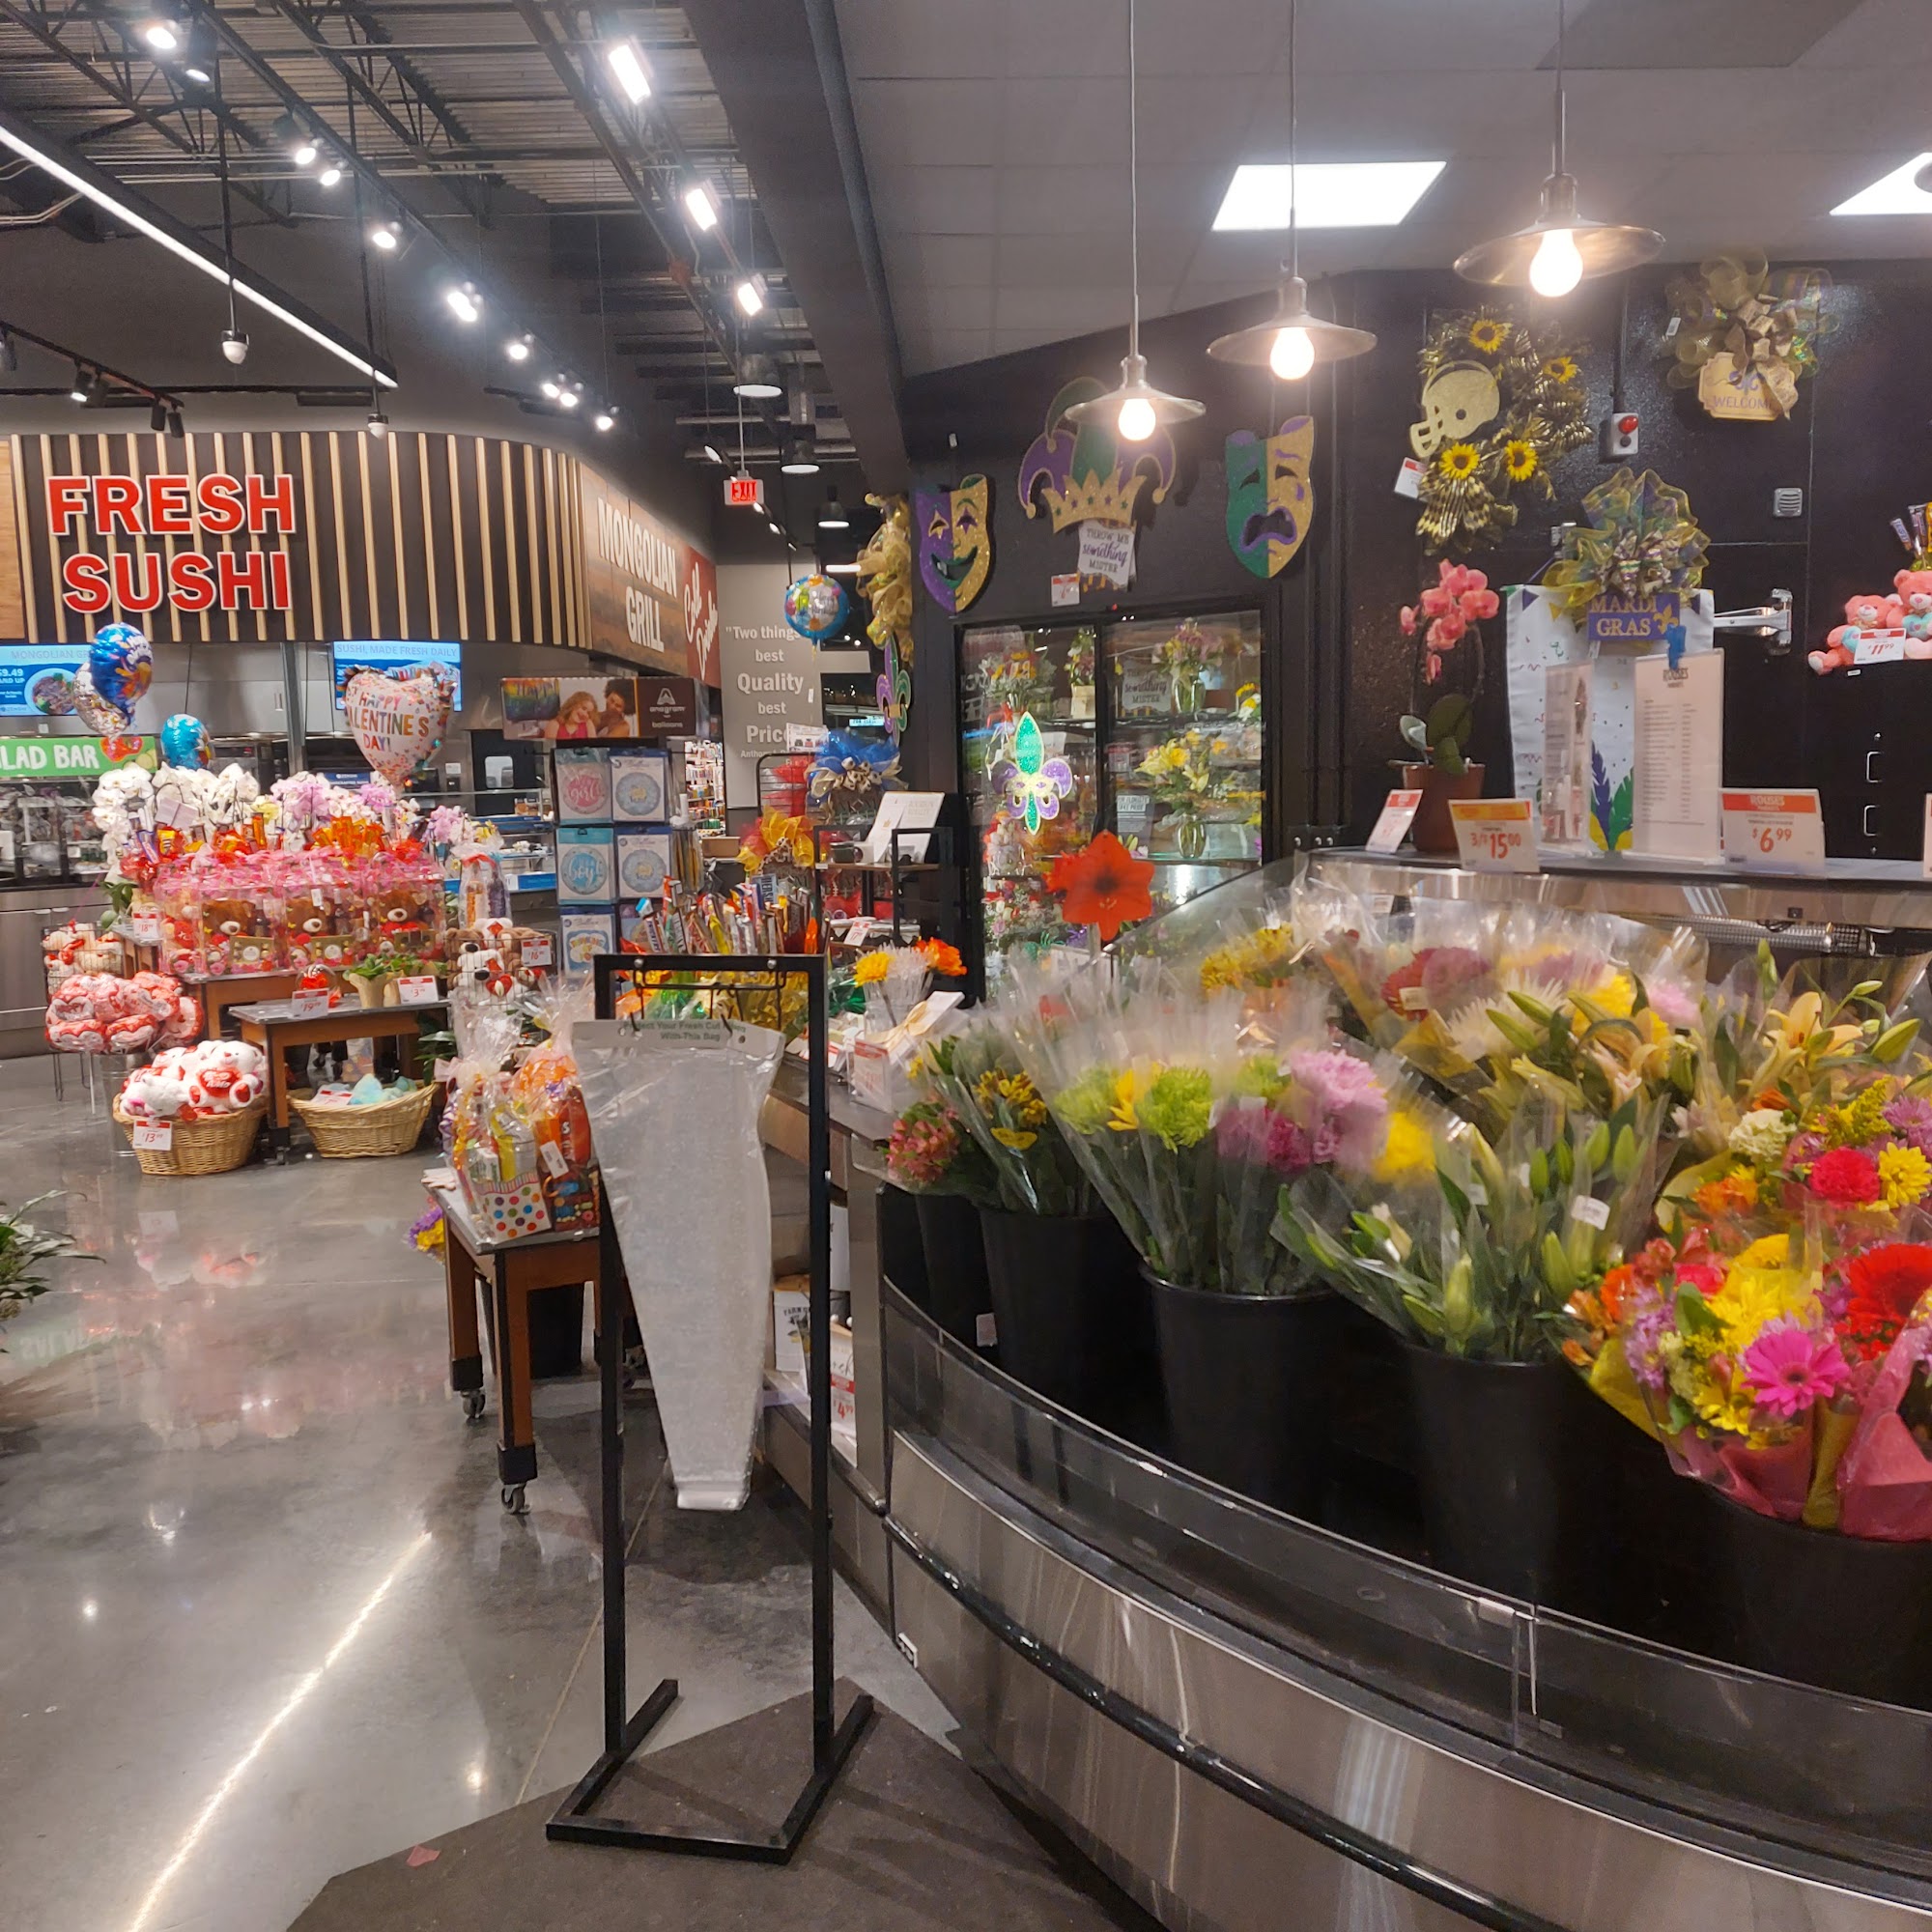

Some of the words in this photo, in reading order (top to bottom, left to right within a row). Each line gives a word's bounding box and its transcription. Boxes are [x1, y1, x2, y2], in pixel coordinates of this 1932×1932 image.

[1714, 395, 1772, 410] WELCOM
[731, 481, 756, 501] EXIT
[46, 473, 297, 536] FRESH
[597, 497, 677, 599] MONGOLIAN
[1083, 541, 1128, 567] something
[1089, 559, 1119, 573] MISTER
[63, 552, 292, 614] SUSHI
[1590, 595, 1658, 612] MARDI
[626, 586, 665, 653] GRILL
[1597, 618, 1651, 637] GRAS
[11, 650, 73, 660] MONGOLIAN
[76, 650, 92, 660] GR
[337, 644, 368, 654] SUSHI,
[370, 645, 397, 655] MADE
[400, 645, 429, 656] FRESH
[431, 647, 457, 657] DAILY
[755, 649, 784, 663] best
[737, 672, 804, 695] Quality
[358, 691, 402, 711] HAPPY
[757, 701, 787, 715] best
[363, 734, 392, 753] DAY!
[746, 724, 788, 744] Pric
[0, 746, 47, 771] LAD
[53, 744, 100, 769] BAR
[657, 1022, 677, 1031] Your
[679, 1022, 703, 1031] Fresh
[706, 1022, 721, 1031] Cut
[703, 1033, 721, 1042] Bag
